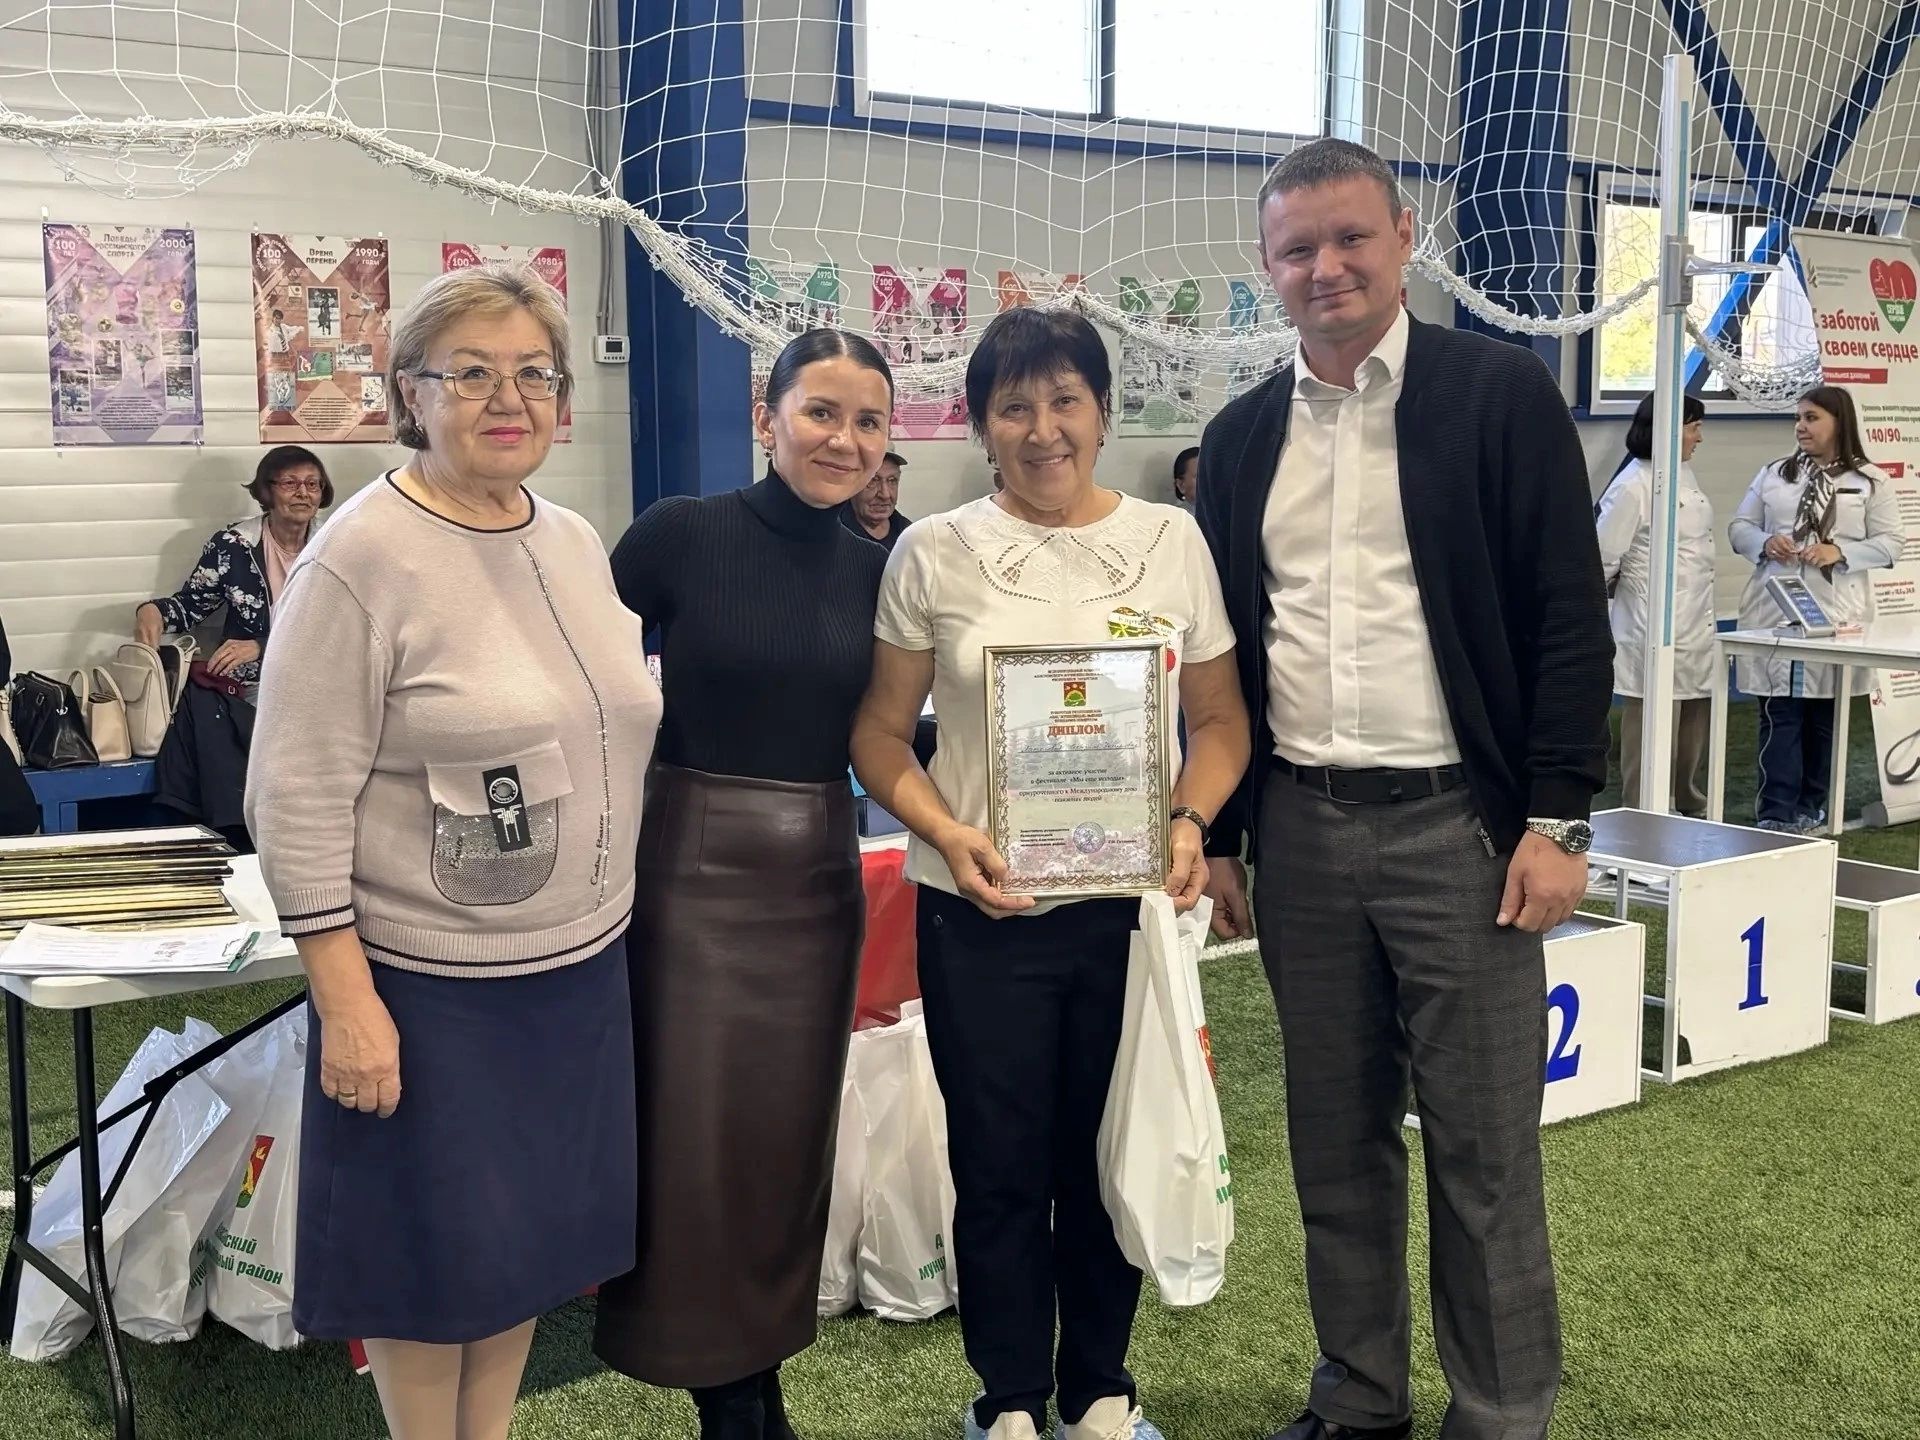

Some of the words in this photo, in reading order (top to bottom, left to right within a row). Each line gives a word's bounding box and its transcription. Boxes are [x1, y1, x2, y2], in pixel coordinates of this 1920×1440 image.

[55, 240, 76, 250] 100
[262, 248, 281, 258] 100
[452, 257, 469, 267] 100
[880, 278, 893, 286] 100
[1820, 308, 1880, 332] заботой
[1825, 340, 1868, 359] своем
[1871, 342, 1919, 363] сердце
[1866, 428, 1900, 443] 140/90
[1047, 724, 1106, 737] ДИПЛОМ
[1738, 916, 1769, 1011] 1
[1545, 983, 1582, 1084] 2
[236, 1261, 284, 1284] район
